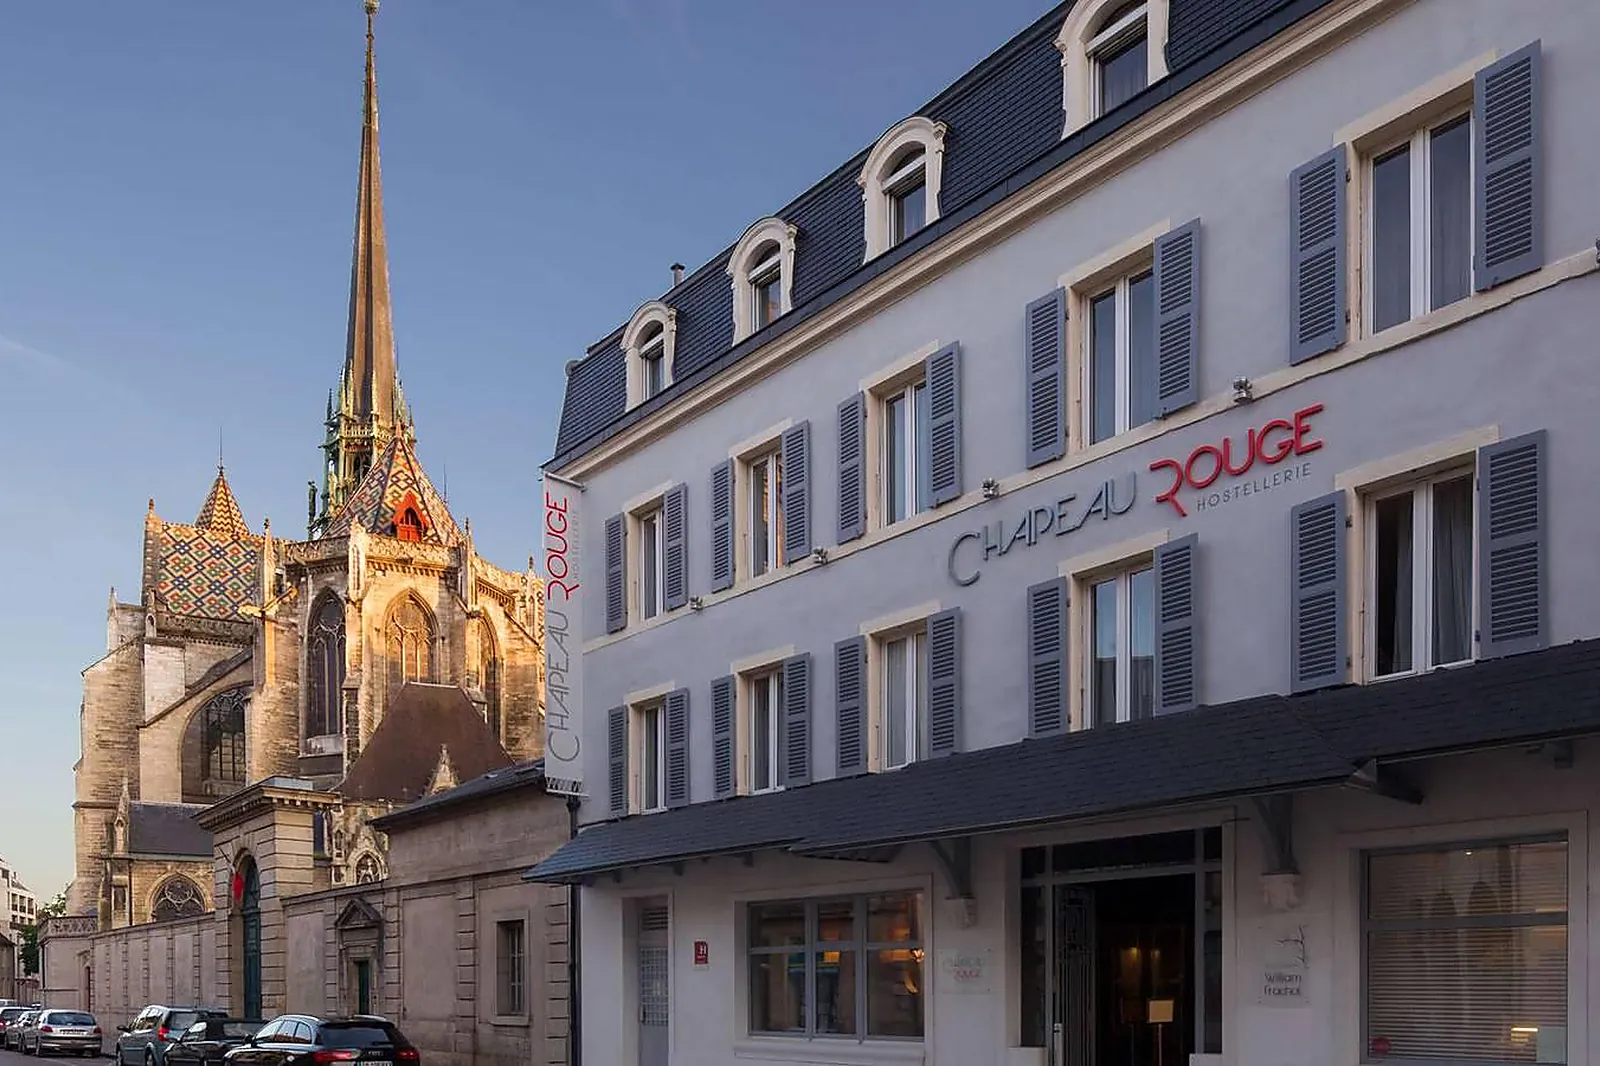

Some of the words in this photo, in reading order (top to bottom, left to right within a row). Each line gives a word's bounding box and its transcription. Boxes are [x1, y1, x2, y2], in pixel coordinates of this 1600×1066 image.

[546, 492, 580, 601] ROUGE
[948, 471, 1137, 587] CHAPEAU
[1149, 403, 1323, 518] ROUGE
[1197, 462, 1313, 512] HOSTELLERIE
[548, 611, 580, 762] CHAPEAU
